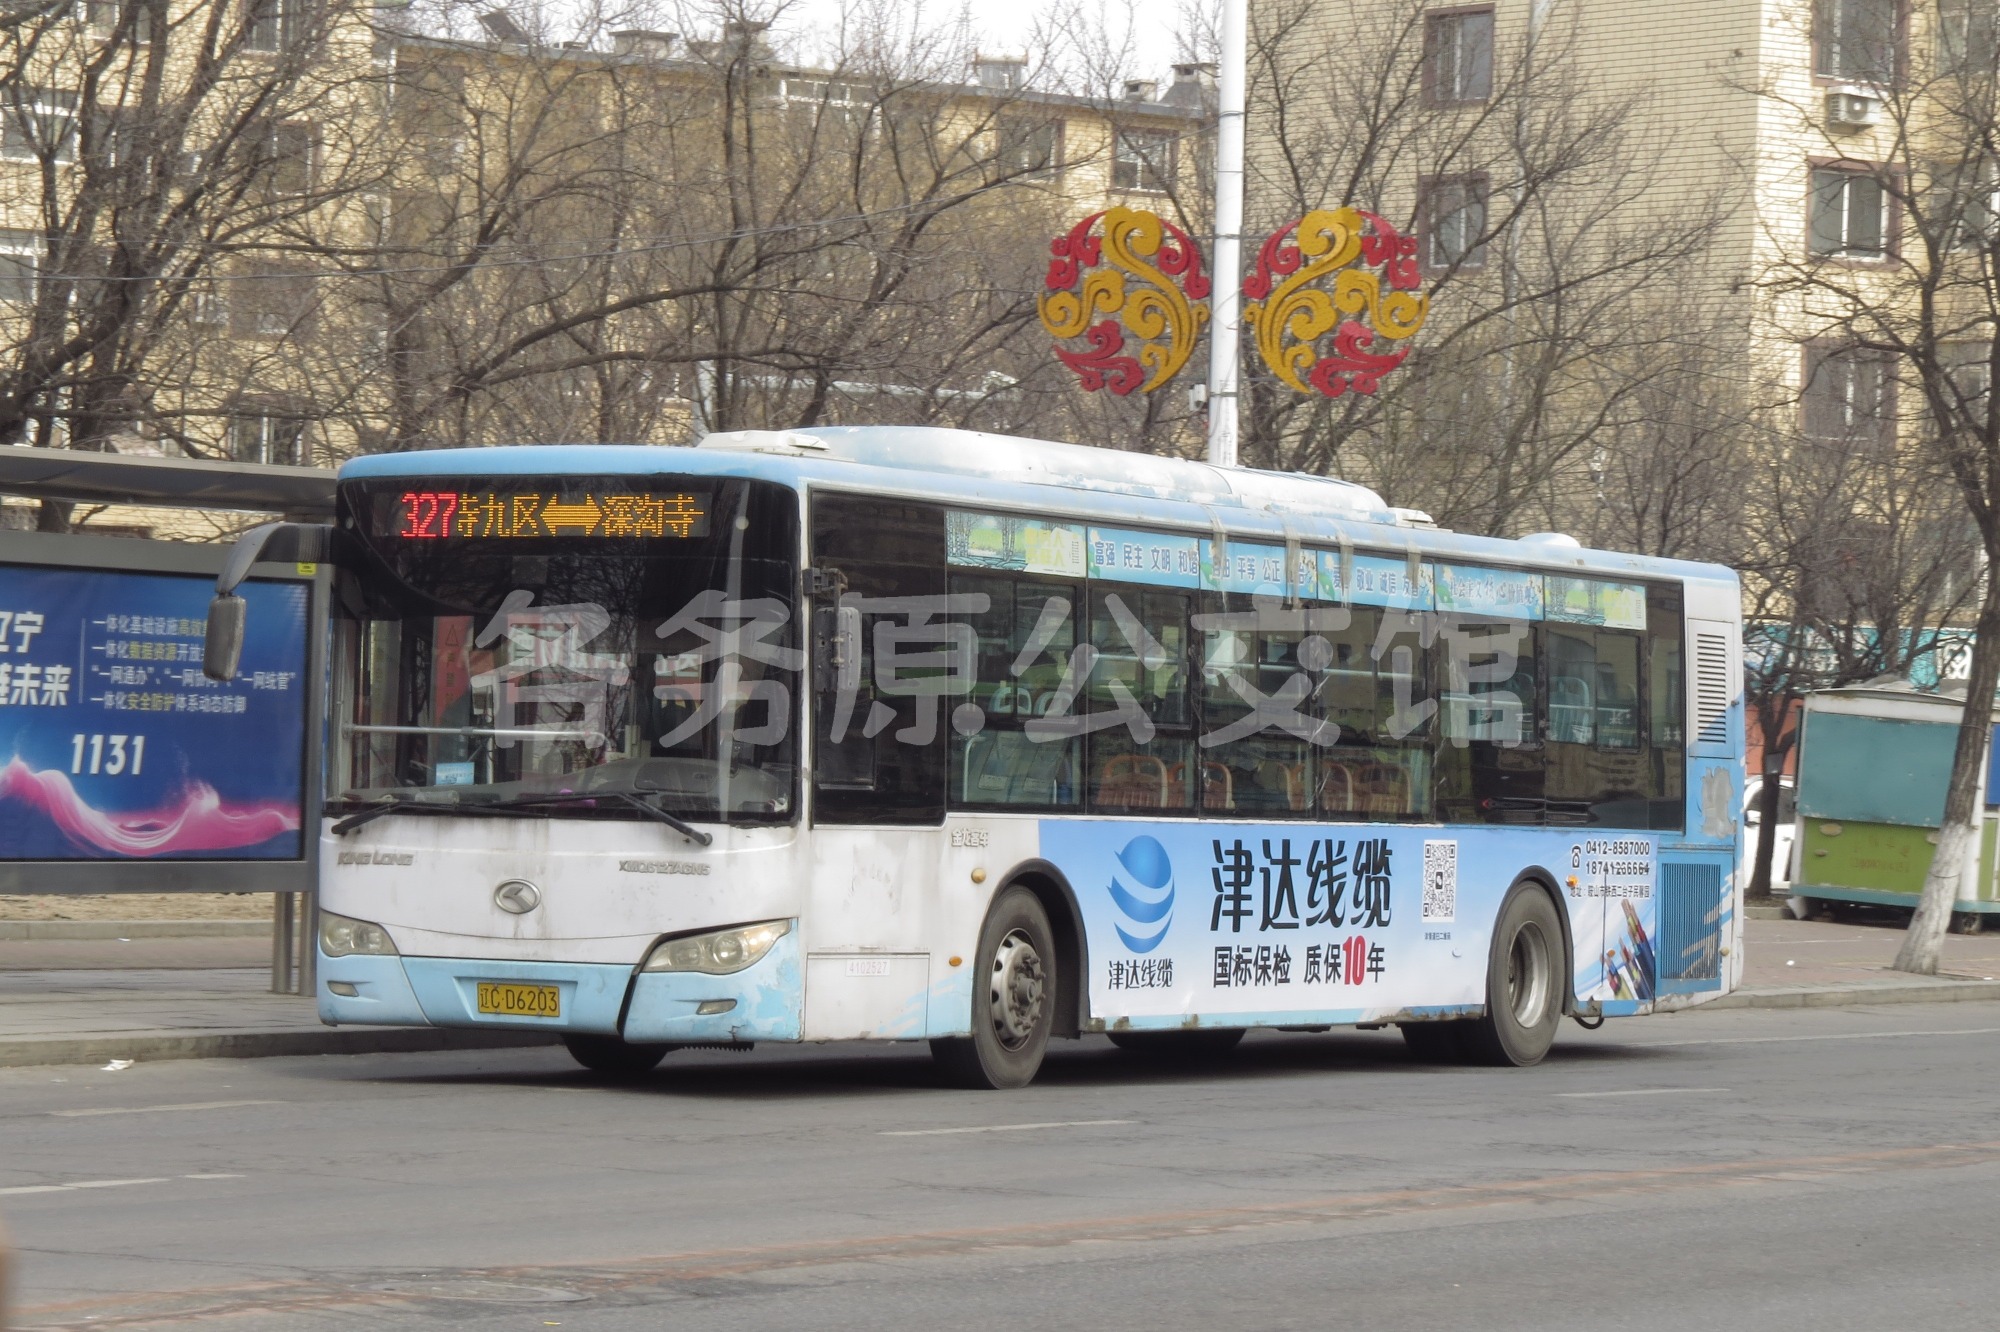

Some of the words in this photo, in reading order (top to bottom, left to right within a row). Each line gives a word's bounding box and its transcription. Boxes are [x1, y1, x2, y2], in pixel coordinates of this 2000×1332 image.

[402, 493, 457, 537] 327
[602, 493, 704, 537] 深沟寺
[1095, 541, 1116, 567] 富强
[1123, 543, 1144, 569] 民主
[1151, 546, 1172, 573] 文明
[1178, 549, 1199, 575] 和谐
[1238, 556, 1256, 581] 平等
[1263, 558, 1281, 583] 公正
[1357, 568, 1374, 592] 敬业
[1379, 571, 1397, 594] 诚信
[91, 639, 206, 664] 一体化数据资源开放
[72, 733, 145, 776] 1131
[951, 827, 989, 847] 金龙客车
[1586, 840, 1650, 855] 0412-8587000
[338, 851, 372, 865] KING
[372, 851, 414, 866] LONG
[1586, 860, 1650, 876] 18741266664
[1210, 838, 1393, 933] 津达线缆
[849, 961, 888, 974] 4102527
[1108, 957, 1173, 990] 津达线缆
[1213, 944, 1291, 988] 国标保检
[1303, 935, 1386, 987] 质保10年
